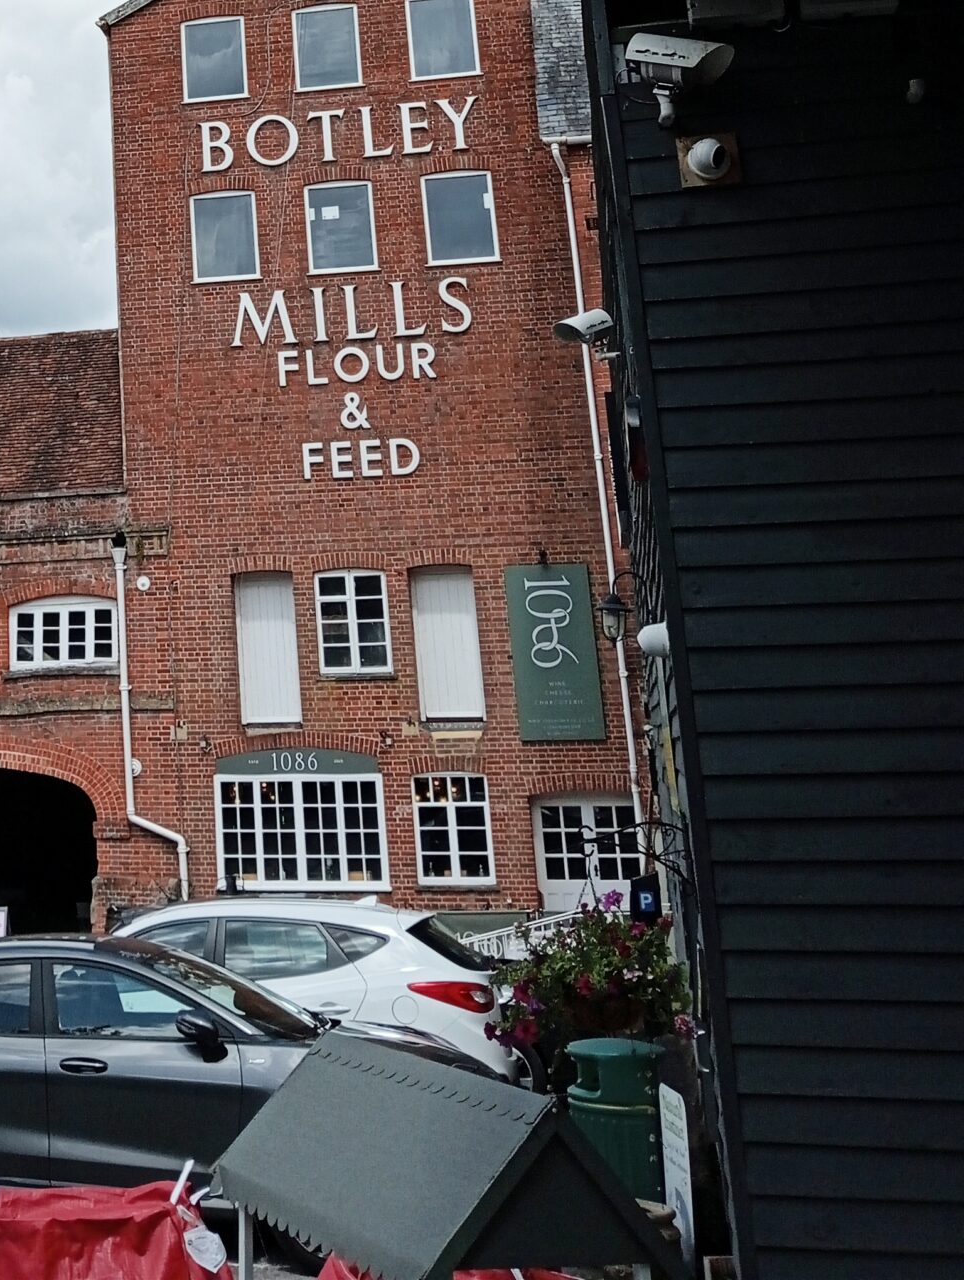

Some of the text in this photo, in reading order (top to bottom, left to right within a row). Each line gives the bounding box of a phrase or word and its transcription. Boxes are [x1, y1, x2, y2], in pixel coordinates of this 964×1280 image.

[198, 95, 478, 172] BOTLEY
[230, 277, 472, 347] MILLS
[277, 342, 437, 387] FLOUR
[340, 392, 371, 429] &
[302, 438, 420, 480] FEED
[523, 575, 579, 668] 1086
[271, 751, 318, 771] 1086
[640, 893, 652, 909] P
